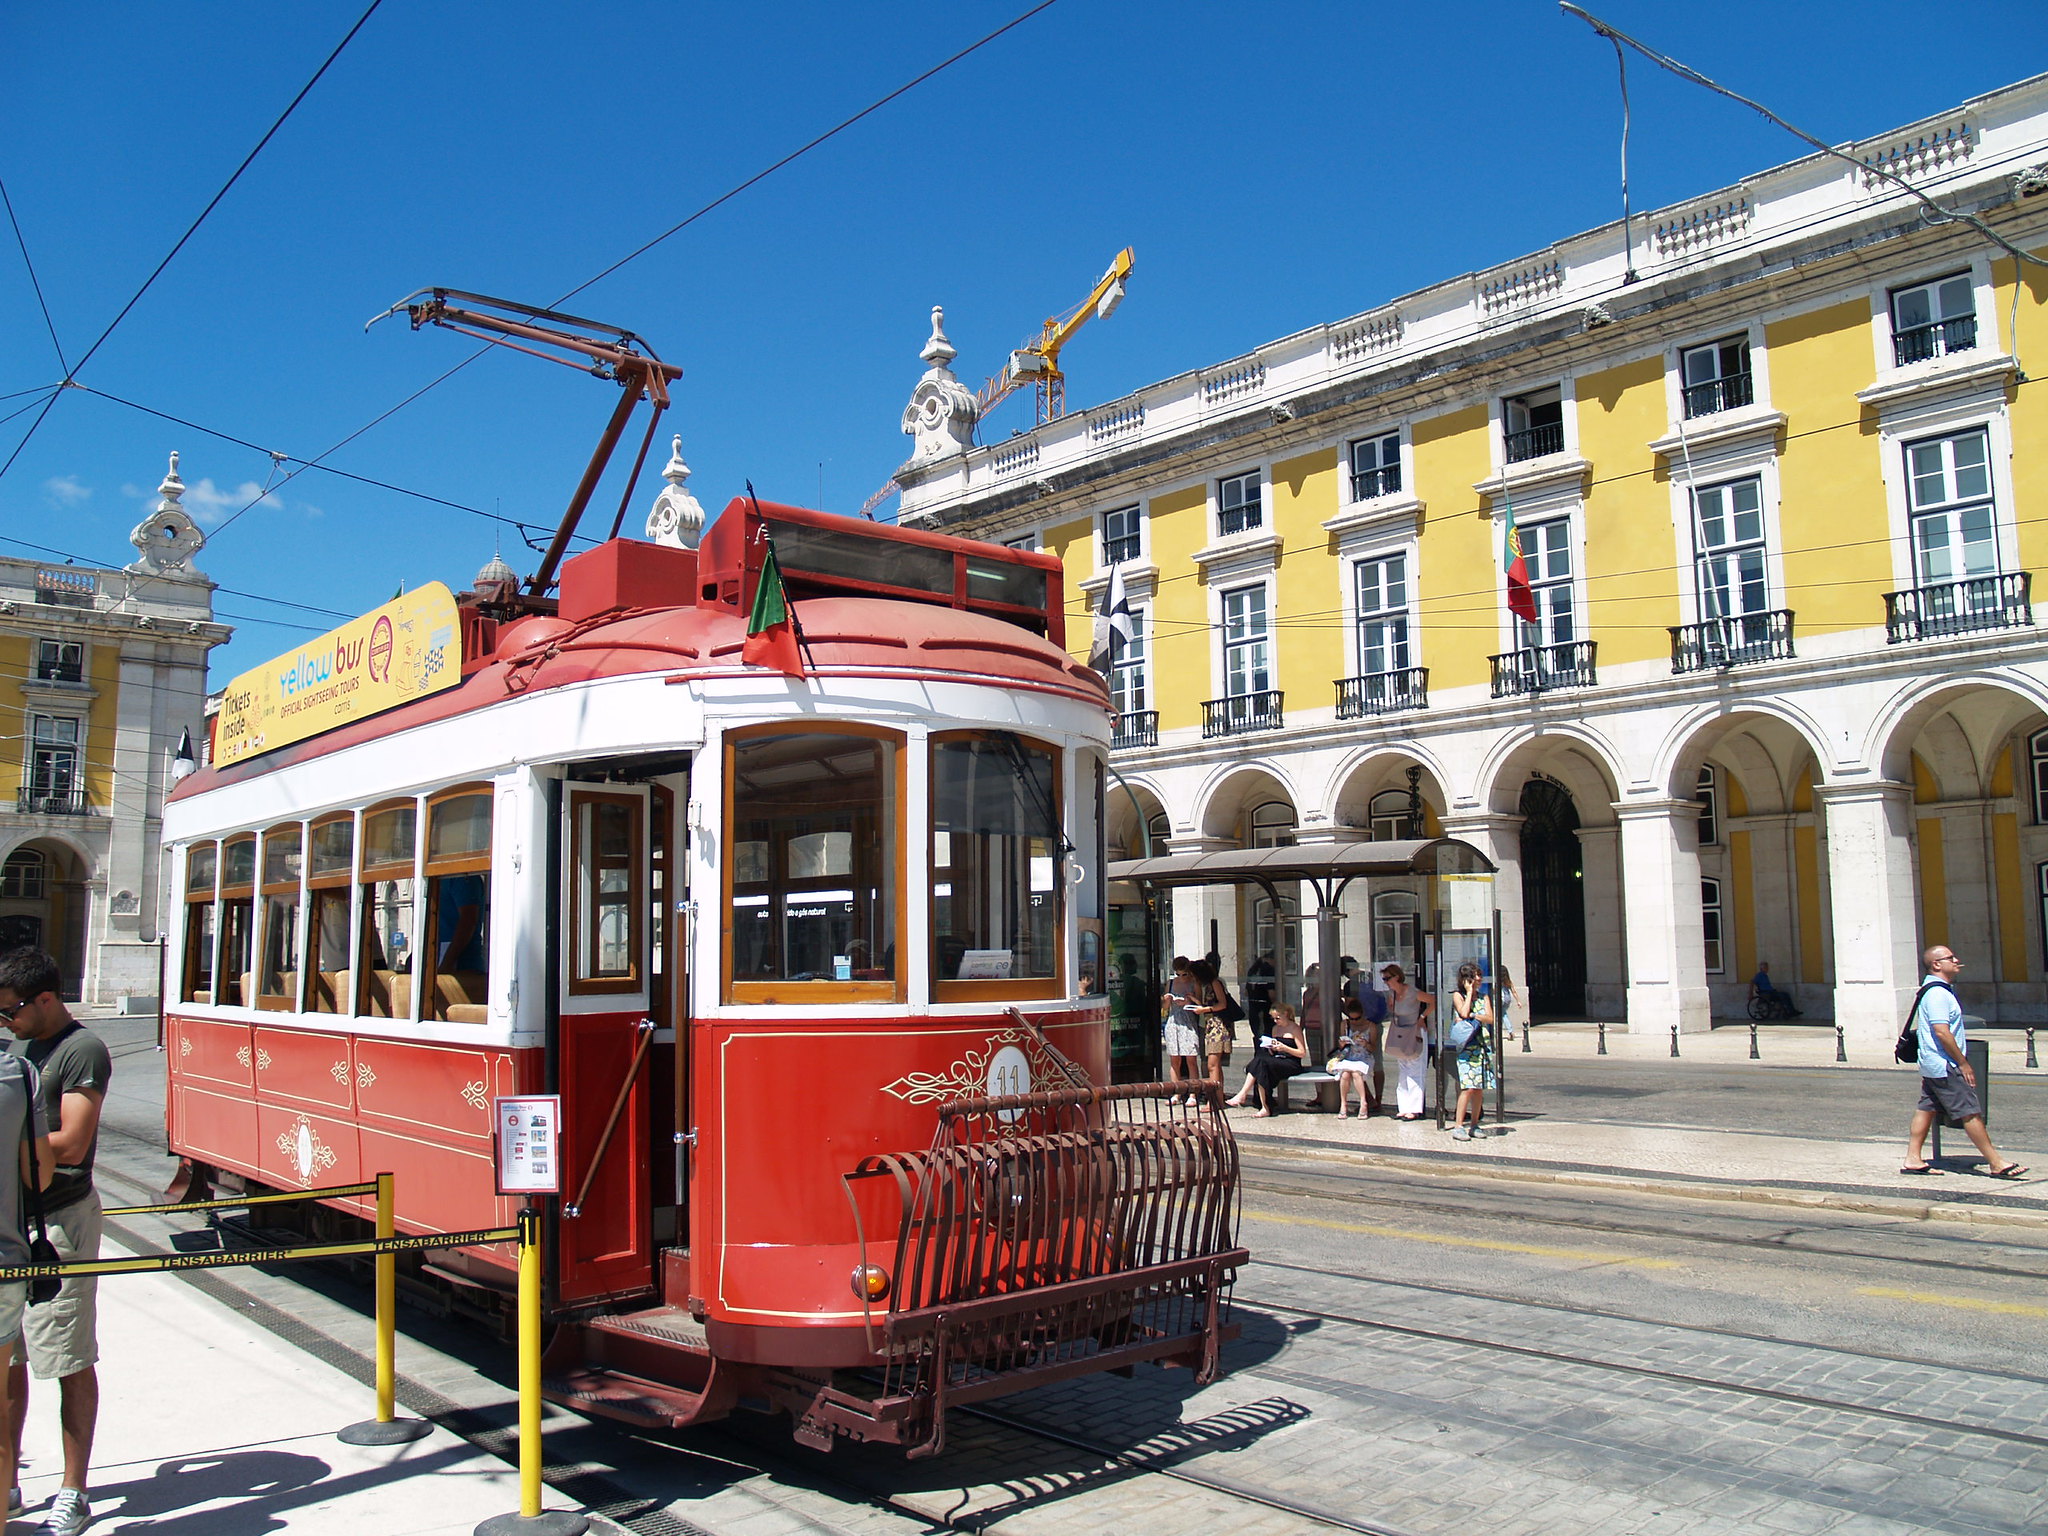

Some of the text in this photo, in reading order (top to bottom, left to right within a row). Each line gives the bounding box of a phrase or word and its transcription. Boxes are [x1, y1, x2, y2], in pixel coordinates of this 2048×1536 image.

[279, 651, 333, 699] yellow
[336, 636, 364, 676] bus
[224, 690, 251, 718] Tickets
[280, 675, 360, 719] OFFICIAL SIGHTSEEING TOURS
[222, 714, 246, 741] inside
[393, 933, 402, 944] P
[996, 1064, 1019, 1096] 11
[373, 1233, 486, 1251] TENSABARRIER
[159, 1250, 287, 1268] TENSABARRIER
